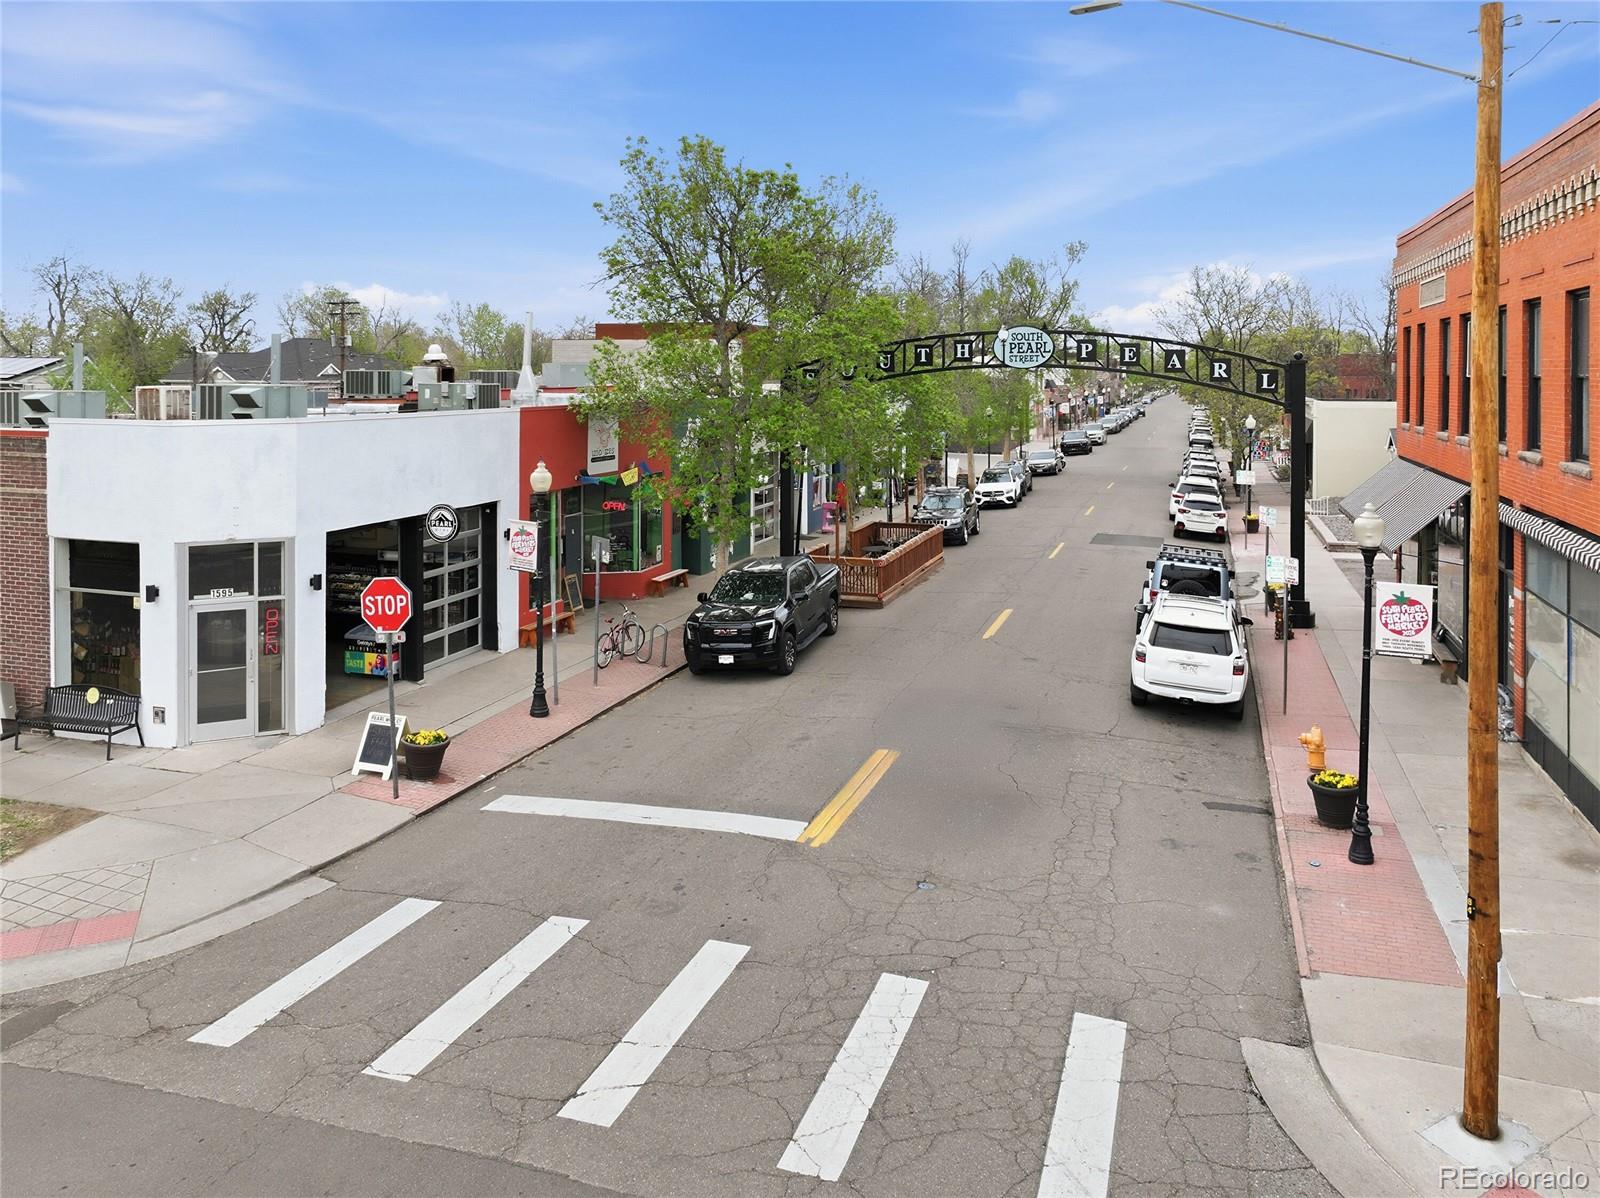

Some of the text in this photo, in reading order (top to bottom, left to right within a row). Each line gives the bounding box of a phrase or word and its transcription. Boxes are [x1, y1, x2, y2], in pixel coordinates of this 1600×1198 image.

[1010, 332, 1043, 342] SOUTH
[1008, 341, 1051, 358] PEARL
[1008, 354, 1041, 364] STREET
[1080, 343, 1276, 389] PEARL
[602, 501, 626, 511] OPEN
[211, 588, 233, 598] 1595
[365, 594, 407, 616] STOP
[1381, 604, 1426, 614] SOUTH PEARL
[1381, 612, 1428, 623] FARMERS
[265, 608, 279, 654] OPEN
[1387, 621, 1425, 631] MARKET
